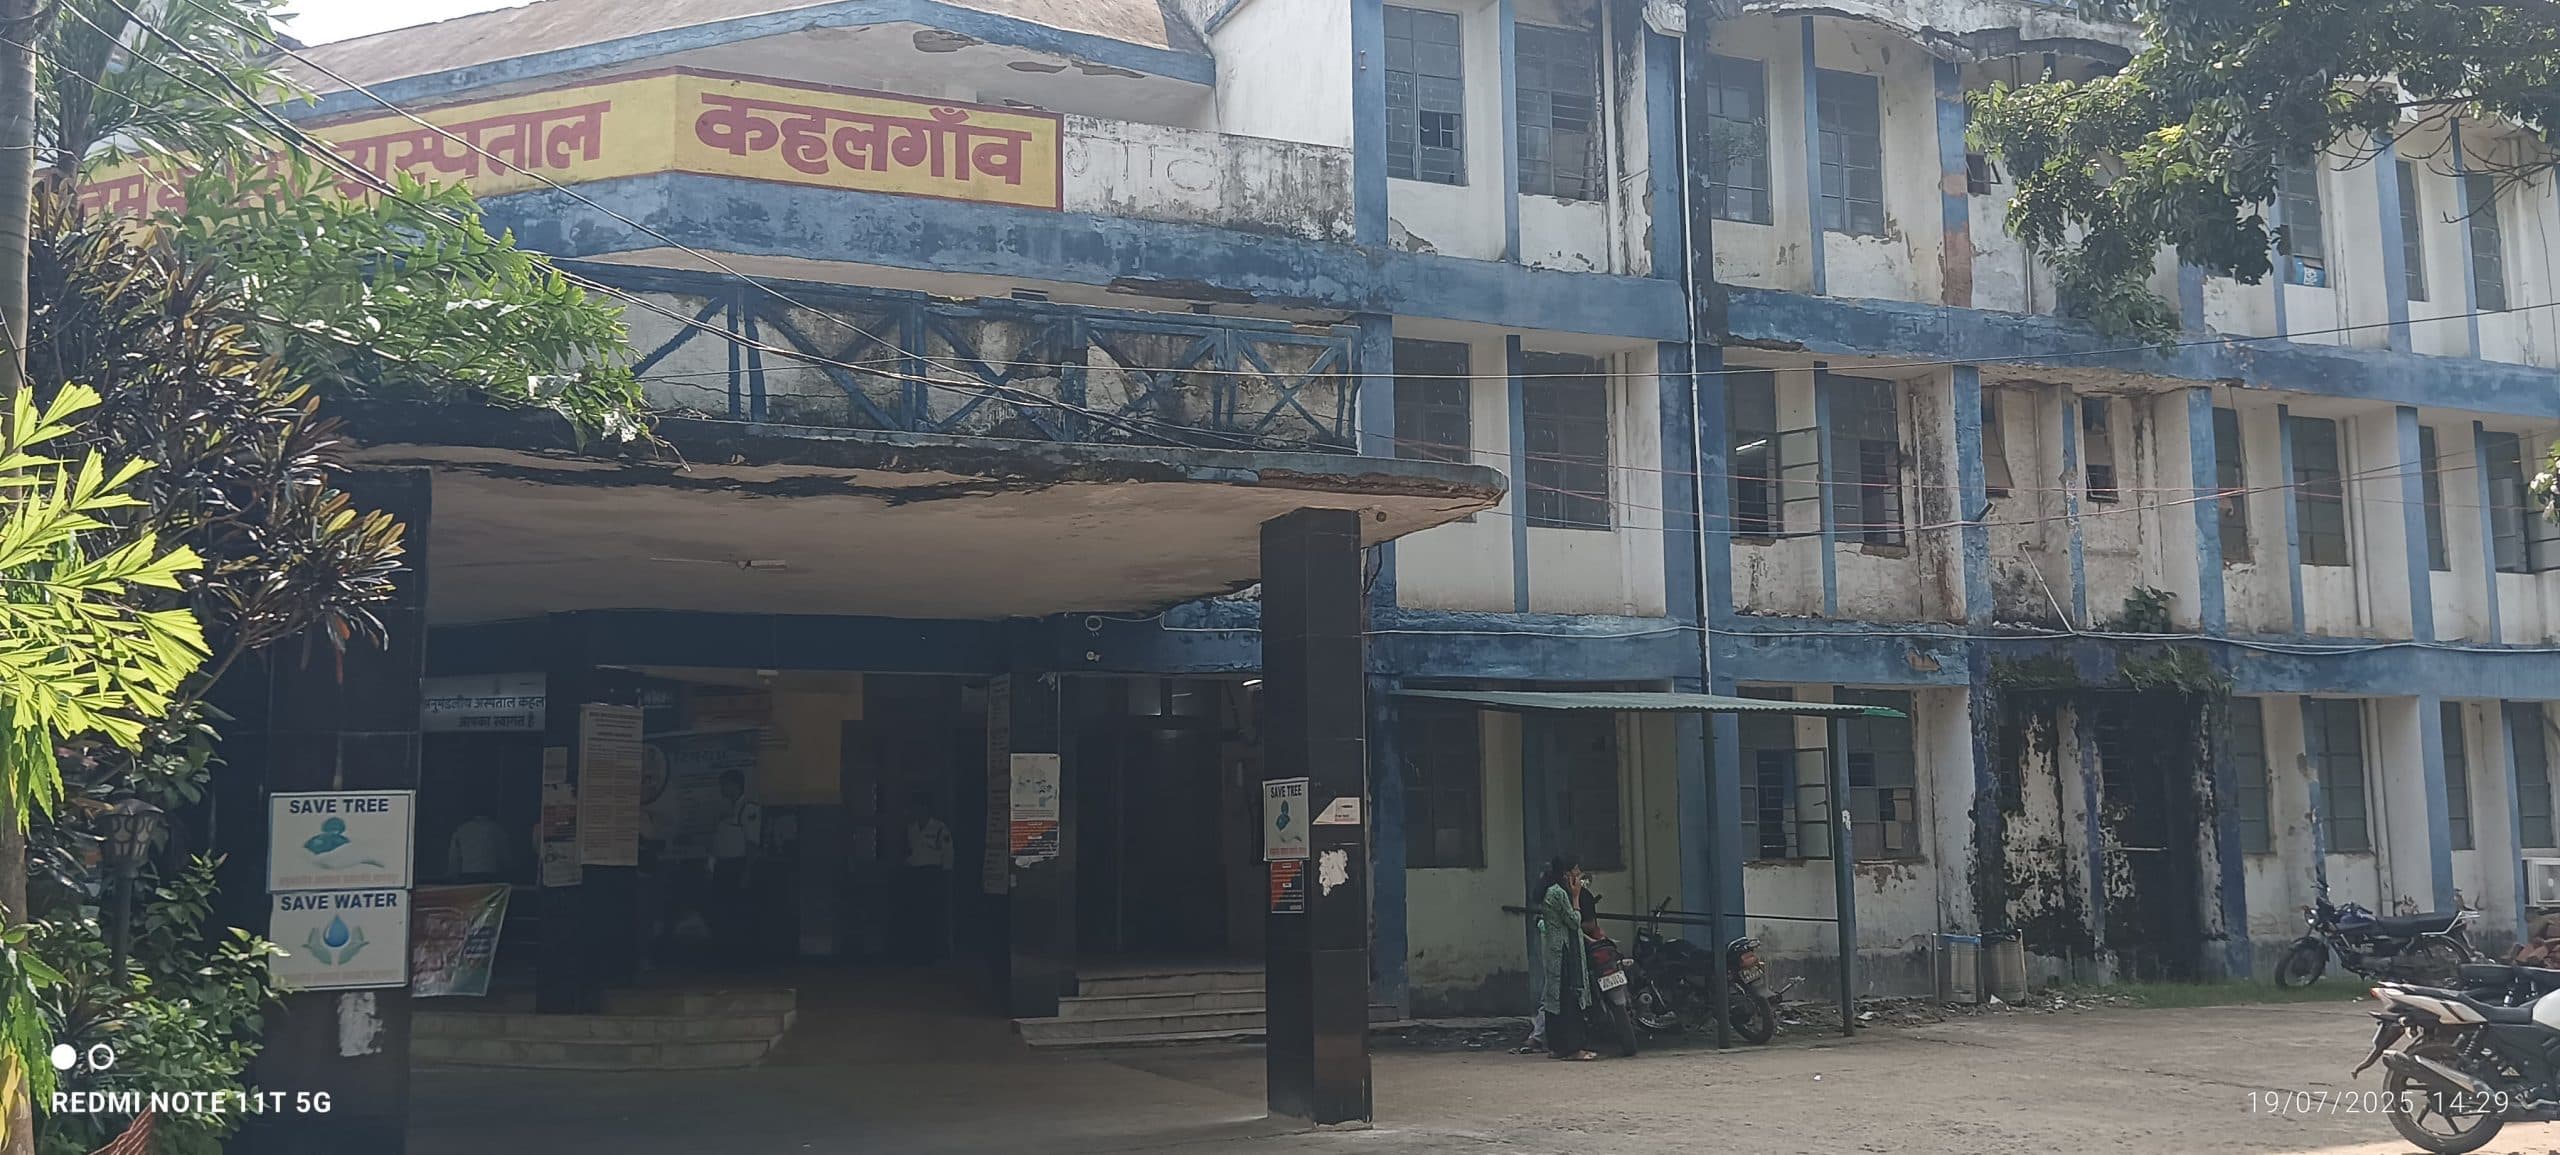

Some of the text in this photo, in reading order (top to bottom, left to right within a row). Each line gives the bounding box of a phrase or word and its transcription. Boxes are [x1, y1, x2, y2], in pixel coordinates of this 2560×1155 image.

[695, 92, 1033, 186] कहलगाँव
[1270, 783, 1302, 799] SAVE TREE
[290, 798, 389, 814] SAVE TREE
[281, 893, 397, 911] SAVE WATER
